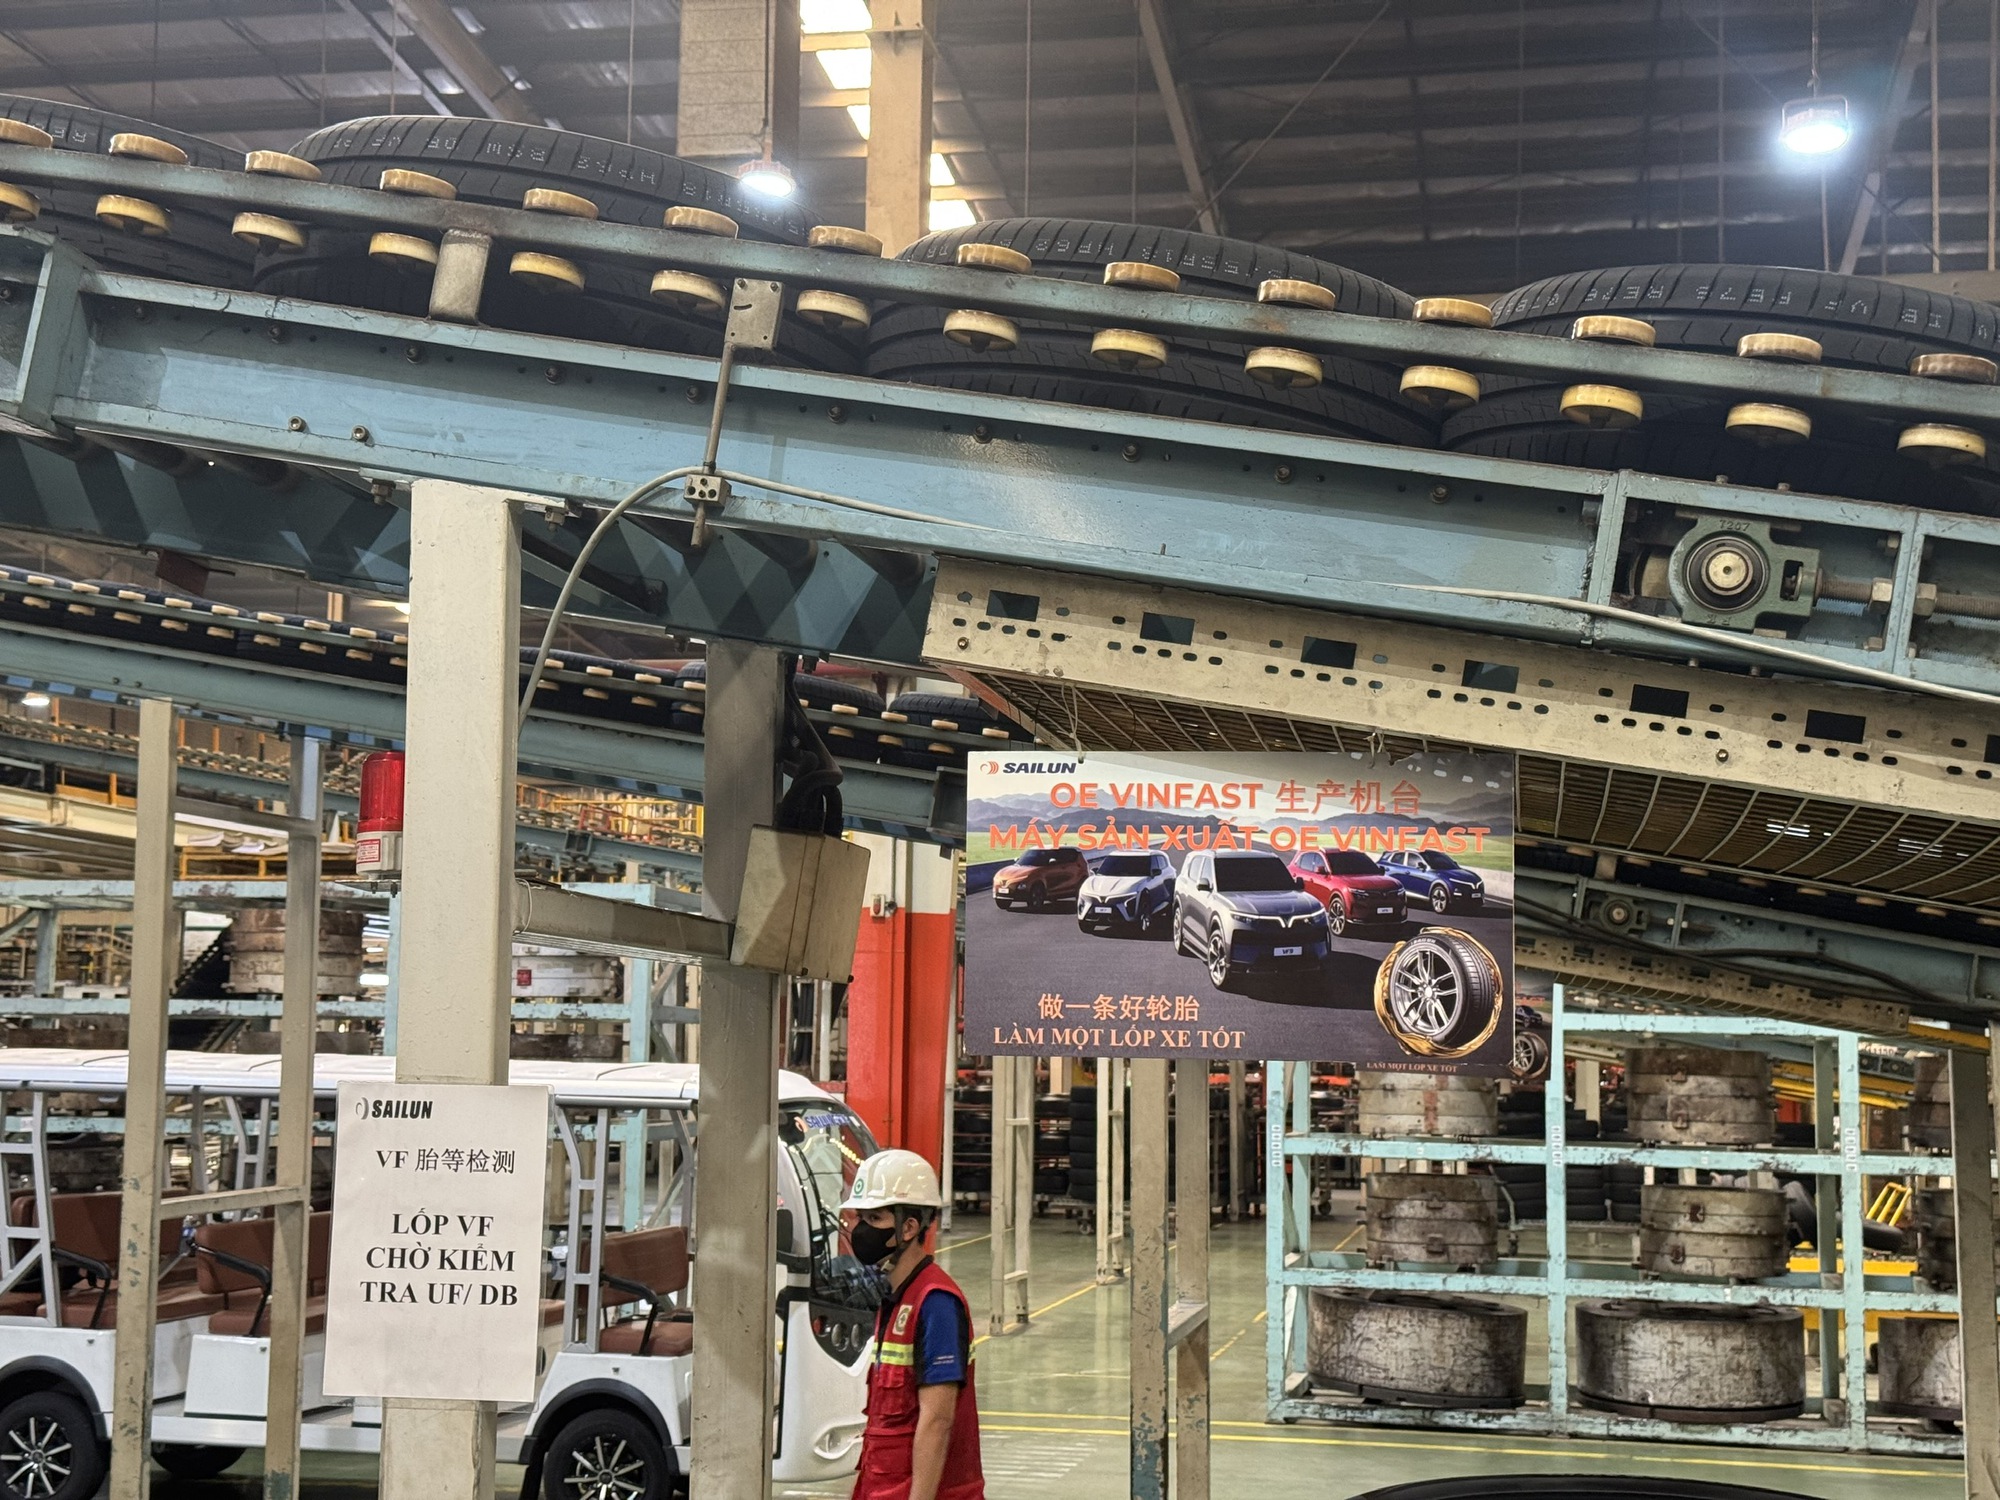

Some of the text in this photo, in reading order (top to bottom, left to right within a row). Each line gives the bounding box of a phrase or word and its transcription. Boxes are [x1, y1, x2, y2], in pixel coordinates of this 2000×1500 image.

[1002, 762, 1077, 774] SAILUN
[1050, 779, 1422, 815] OE VINFAST 生产机台
[989, 815, 1491, 853] MÁY SẢN XUẤT OE VINFAST
[1037, 993, 1200, 1021] 做一条好轮胎
[993, 1022, 1246, 1050] LÀM MỘT LỐP XE TỐT
[371, 1099, 434, 1120] SAILUN
[376, 1147, 516, 1175] VF 胎等检测
[391, 1207, 494, 1237] LỐP VF
[366, 1241, 516, 1272] CHỜ KIỂM
[360, 1281, 519, 1306] TRA UF/ DB
